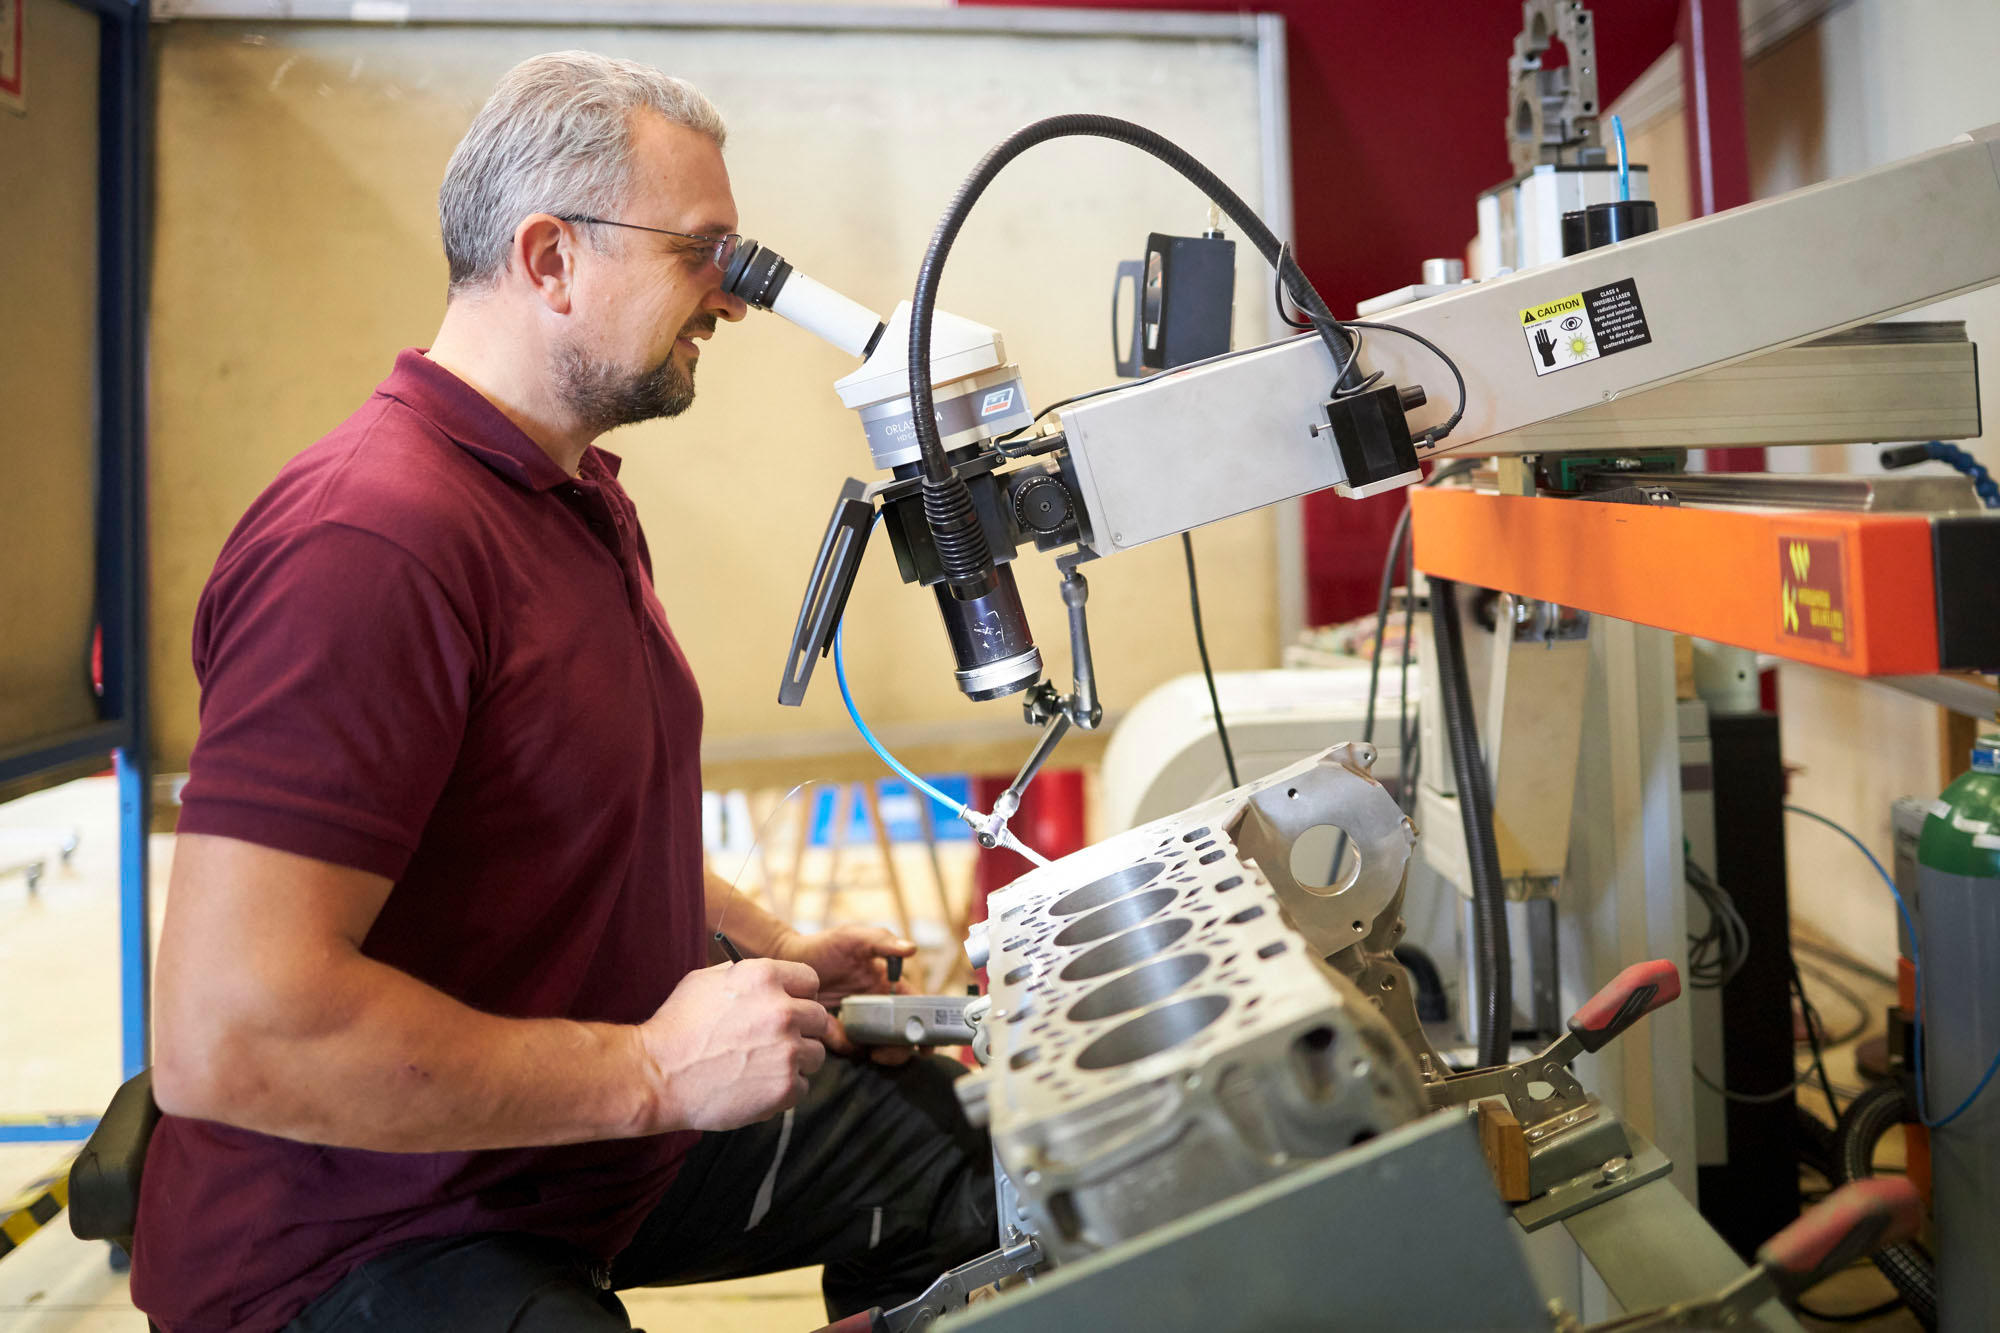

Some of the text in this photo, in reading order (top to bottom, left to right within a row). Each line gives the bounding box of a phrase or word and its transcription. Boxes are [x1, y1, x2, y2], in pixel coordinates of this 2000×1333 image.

[1600, 289, 1615, 297] CLASS
[1593, 292, 1631, 307] INVISIBLE LASER
[1537, 299, 1580, 317] CAUTION
[1597, 305, 1617, 313] radiation
[1615, 306, 1637, 315] interlocks
[1602, 313, 1634, 327] defeated avoid
[1622, 320, 1643, 328] exposure
[1603, 334, 1645, 349] scattered radiation
